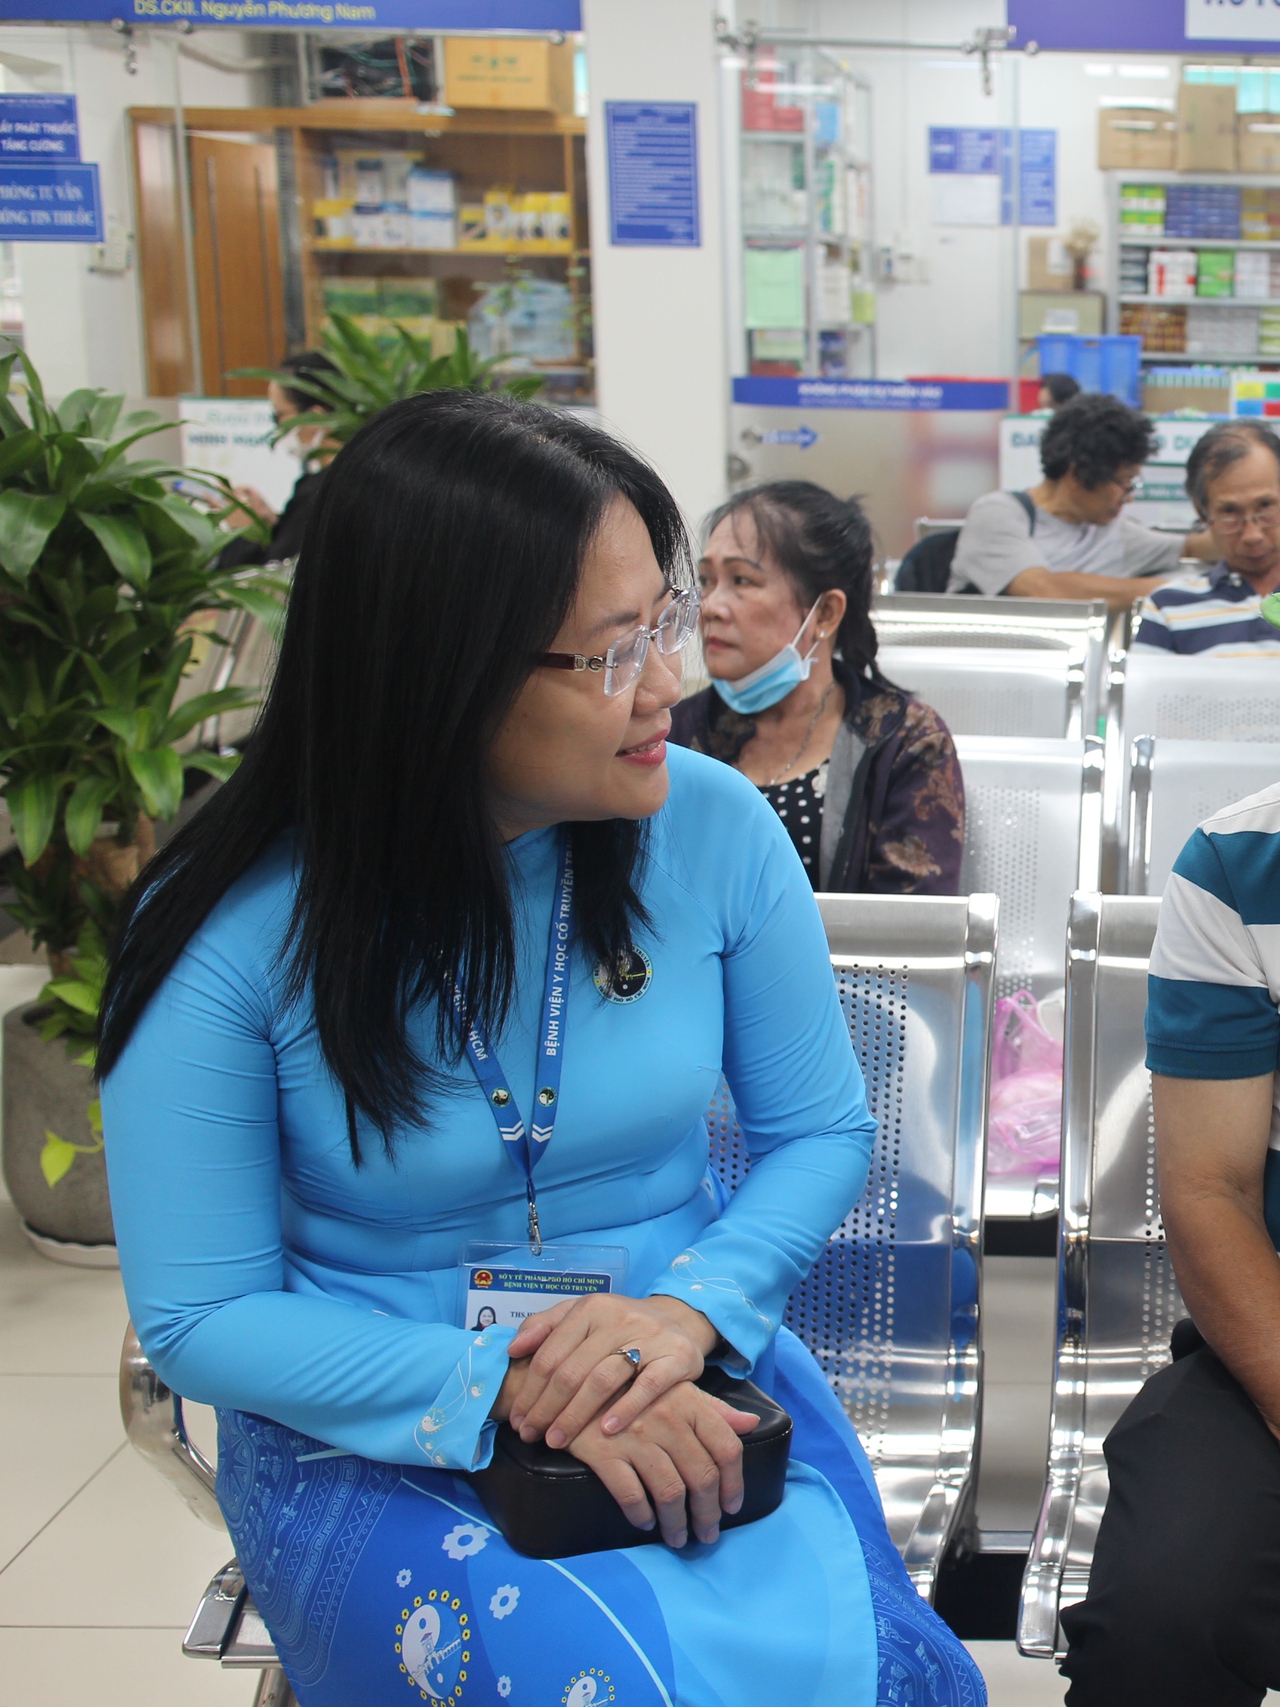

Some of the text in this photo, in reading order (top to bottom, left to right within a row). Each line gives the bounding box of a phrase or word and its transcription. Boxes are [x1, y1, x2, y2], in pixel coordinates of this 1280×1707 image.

[335, 4, 376, 20] Nam
[560, 868, 574, 919] TRUYỀN
[555, 922, 569, 941] CỔ
[554, 943, 569, 972] HỌC
[553, 973, 564, 983] Y
[548, 986, 565, 1018] VIỆN
[544, 1020, 561, 1057] BỆNH
[504, 1281, 522, 1289] BỆNH
[523, 1282, 538, 1290] VIỆN
[545, 1283, 560, 1291] HỌC
[524, 1274, 547, 1282] THÀNH
